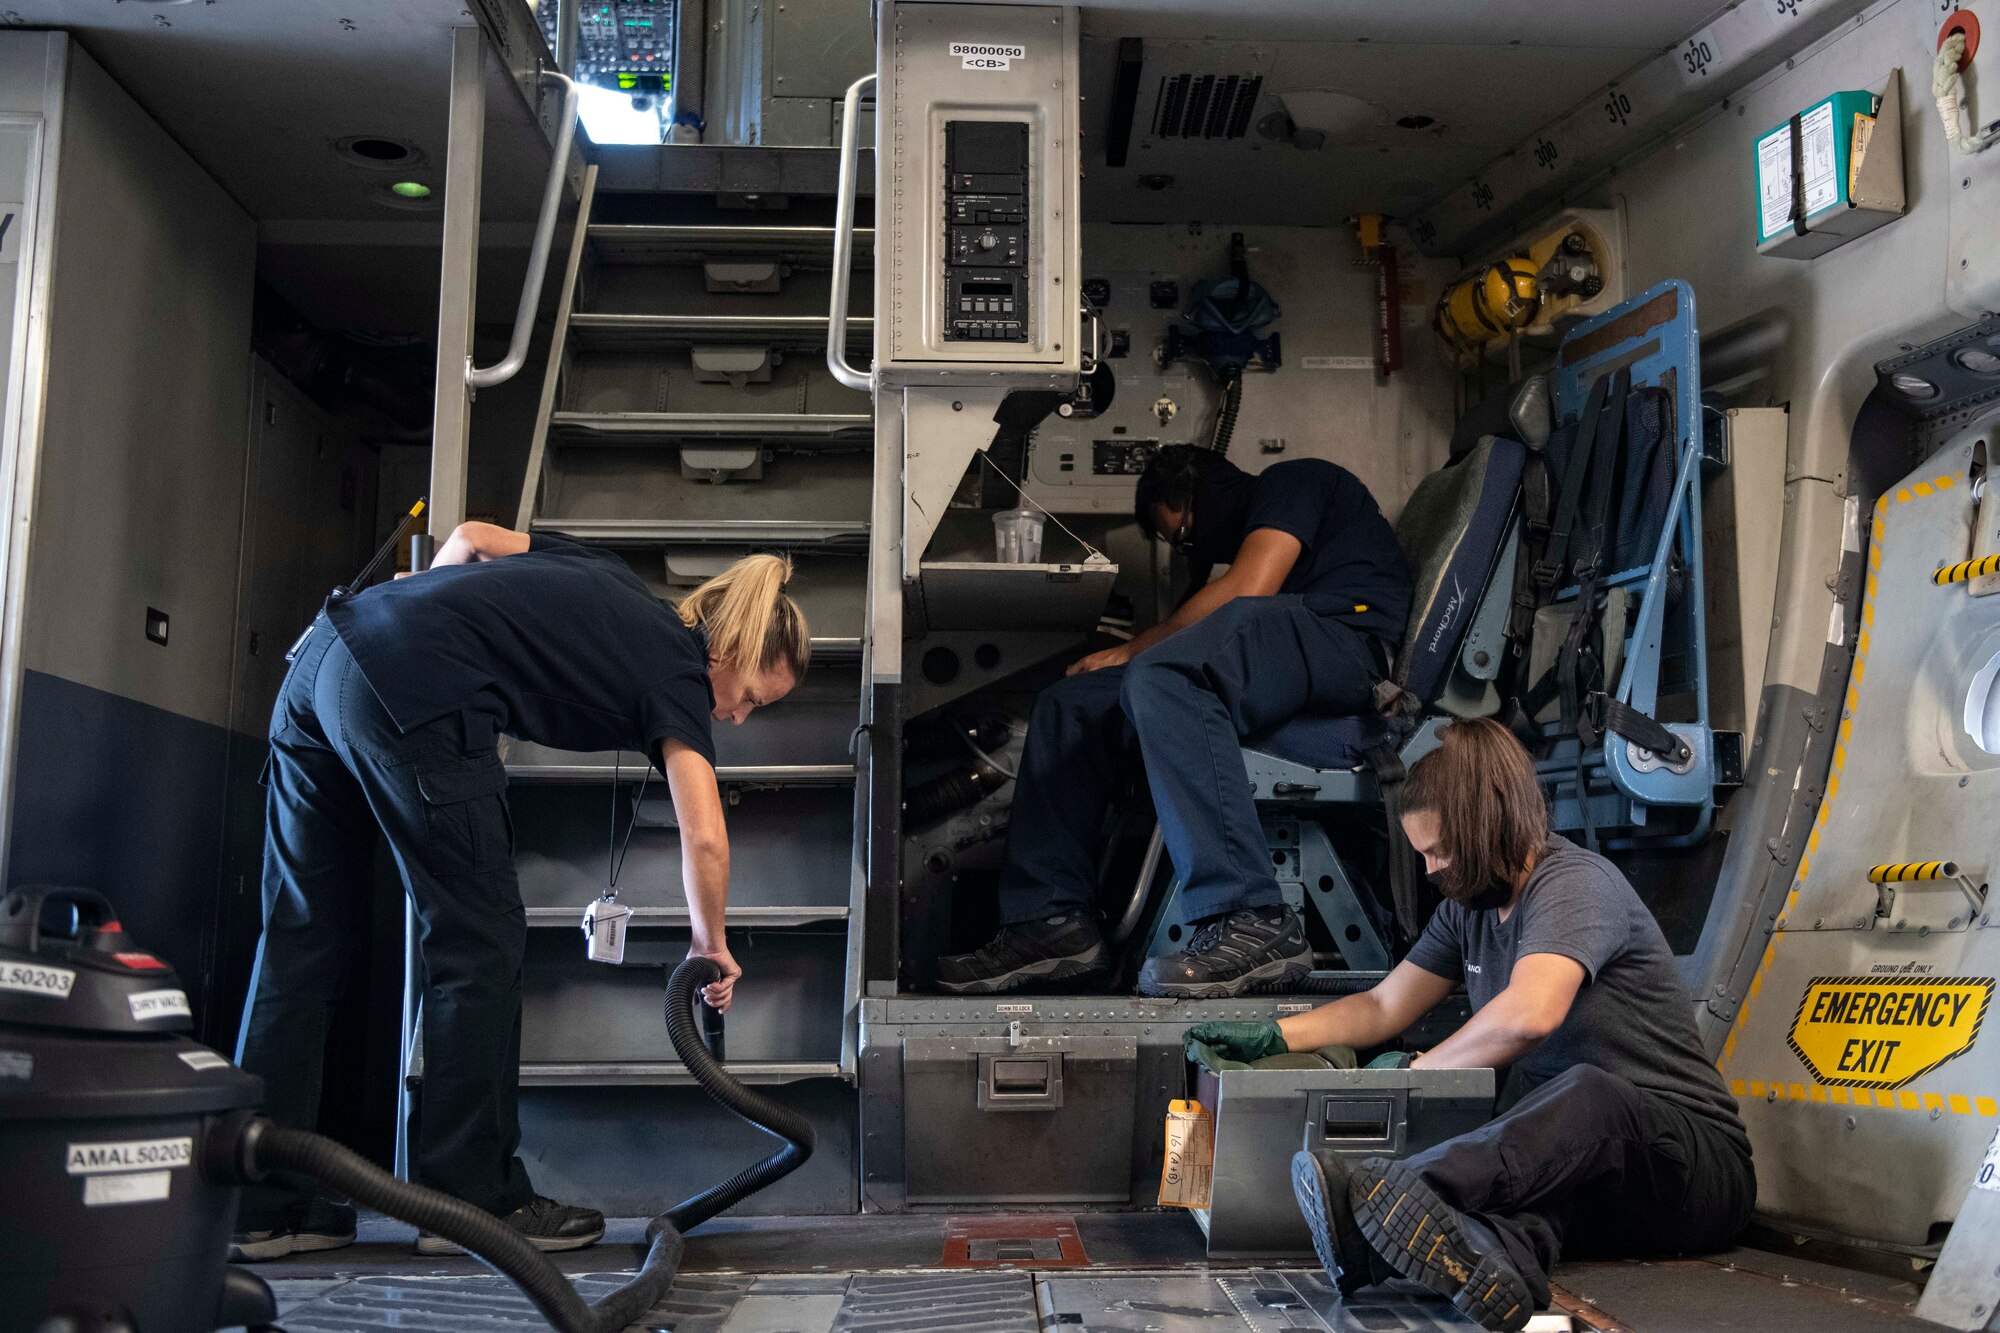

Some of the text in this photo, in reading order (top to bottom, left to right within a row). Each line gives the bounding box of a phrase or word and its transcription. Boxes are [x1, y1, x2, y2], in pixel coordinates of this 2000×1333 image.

[953, 45, 1022, 57] 98000050
[965, 59, 1006, 68] <CB>
[1683, 41, 1713, 74] 320
[1605, 94, 1632, 124] 310
[1534, 141, 1558, 168] 300
[1472, 184, 1494, 209] 290
[1429, 596, 1458, 653] McChord
[1871, 964, 1934, 973] GROUND USE ONLY
[1809, 992, 1971, 1027] EMERGENCY
[1837, 1039, 1901, 1074] EXIT
[1171, 1134, 1182, 1147] 16
[70, 1144, 191, 1167] AMAL50203
